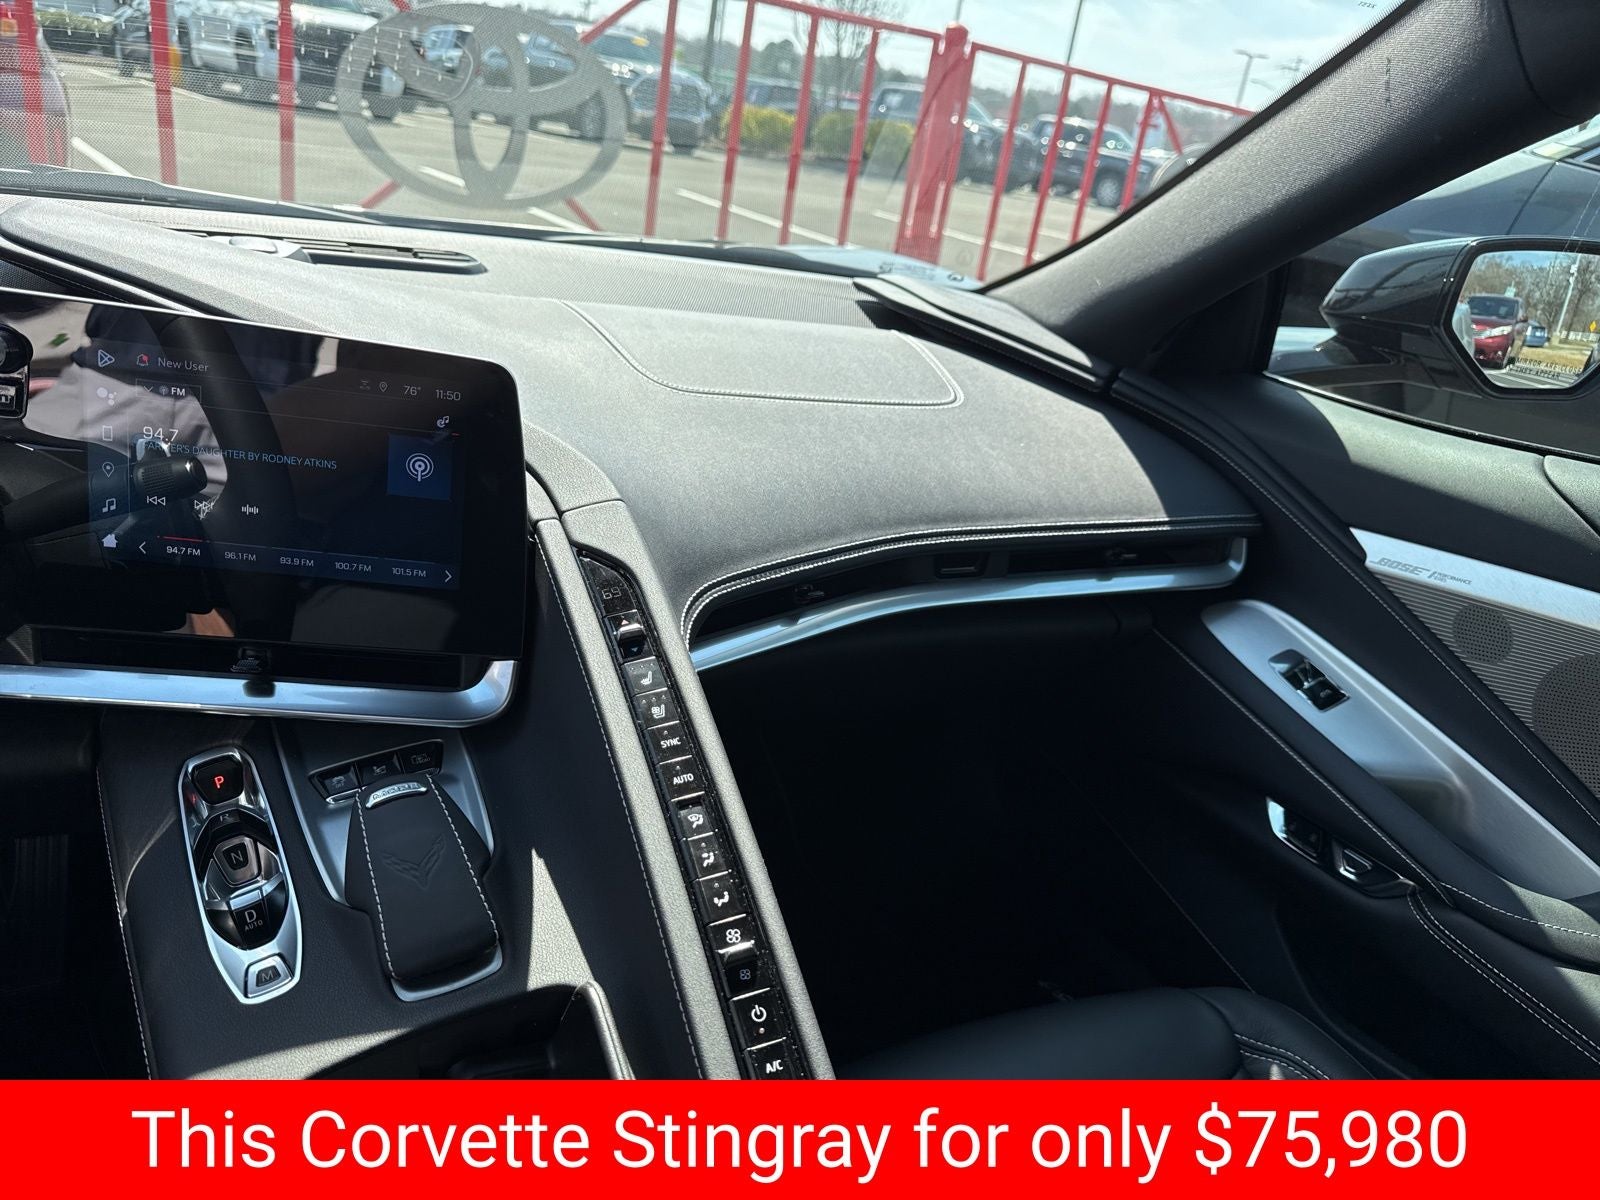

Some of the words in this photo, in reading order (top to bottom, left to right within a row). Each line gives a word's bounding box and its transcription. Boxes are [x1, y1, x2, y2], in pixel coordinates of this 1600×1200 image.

[157, 357, 182, 370] New
[184, 360, 209, 372] User
[1560, 364, 1584, 375] CLOSE
[171, 386, 186, 397] FM
[402, 385, 422, 396] 76°
[435, 389, 461, 401] 11:50
[143, 426, 179, 442] 94.7
[143, 442, 190, 454] FARER'S
[192, 446, 246, 460] DAUGHTER
[247, 452, 261, 462] BY
[261, 452, 303, 466] RODNEY
[303, 457, 337, 470] ATKINS
[166, 546, 186, 555] 94.7
[187, 547, 201, 556] FM
[224, 551, 242, 560] 96.1
[243, 553, 257, 561] FM
[279, 556, 300, 566] 93.9
[301, 558, 314, 568] FM
[335, 561, 357, 571] 100.7
[358, 563, 372, 573] FM
[1370, 557, 1430, 576] BOSE
[392, 567, 412, 576] 101.5
[413, 569, 427, 578] FM
[660, 736, 682, 749] SYNC
[213, 775, 225, 789] P
[672, 772, 694, 785] AUTO
[219, 813, 230, 822] R
[230, 850, 243, 865] N
[244, 909, 257, 924] D
[244, 919, 264, 932] AUTO
[260, 969, 274, 982] M
[765, 1058, 783, 1074] A/C
